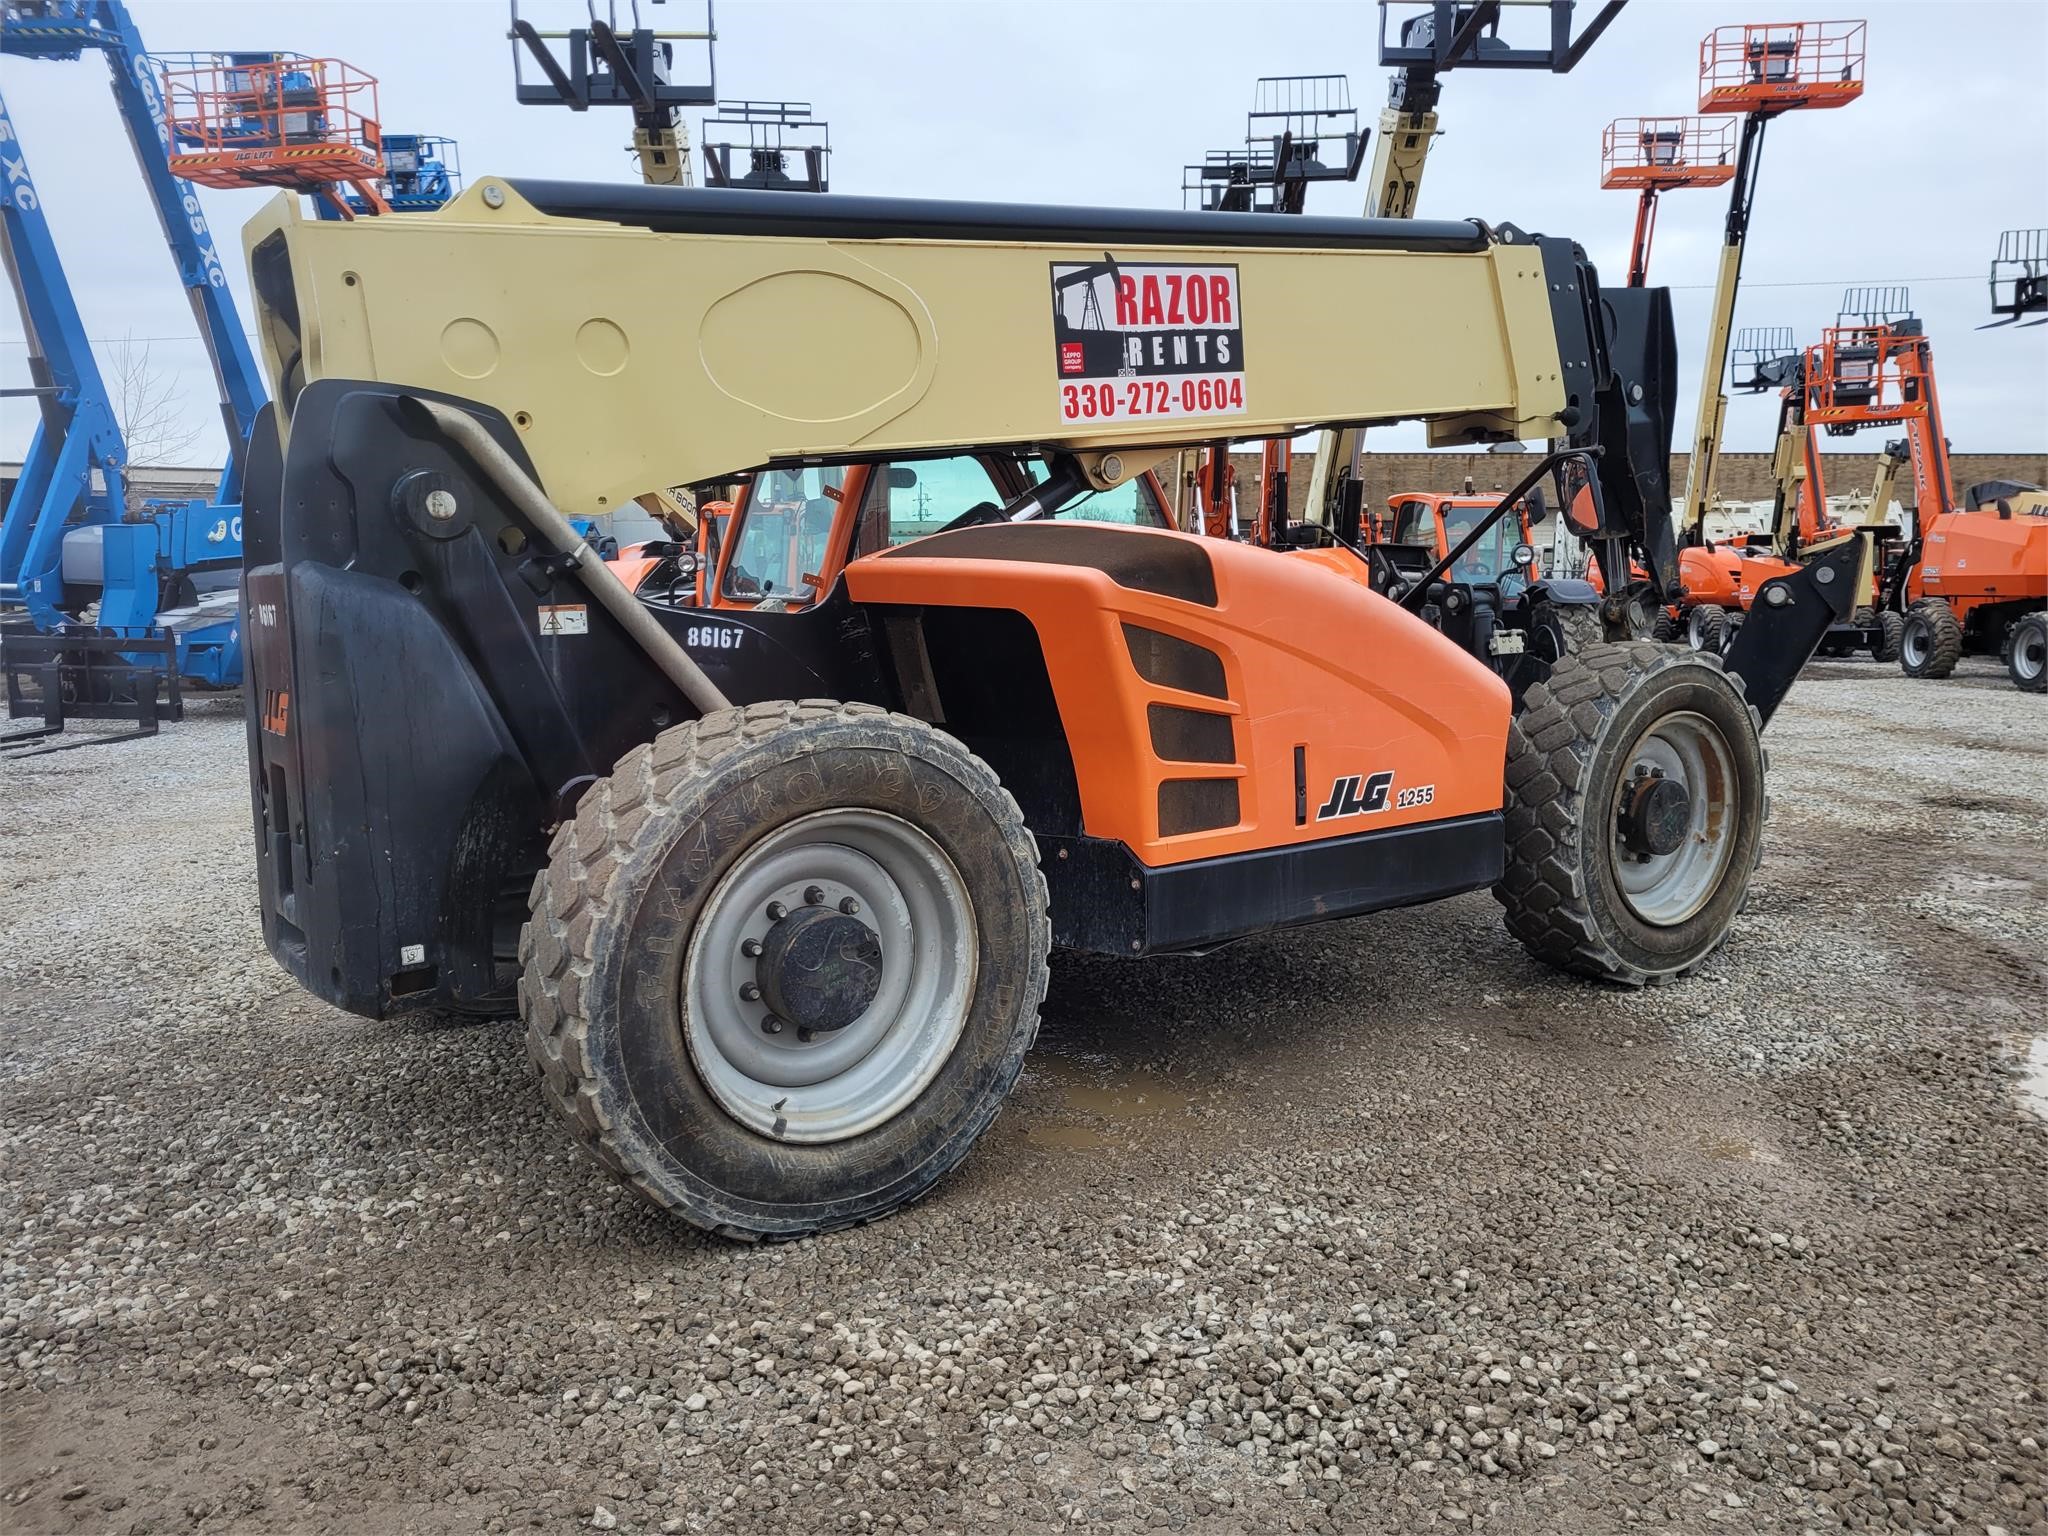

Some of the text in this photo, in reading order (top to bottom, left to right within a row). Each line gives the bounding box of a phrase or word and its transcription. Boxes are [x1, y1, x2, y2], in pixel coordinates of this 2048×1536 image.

[0, 154, 38, 211] XC
[174, 176, 225, 288] -65 XC
[1115, 274, 1232, 325] RAZOR
[1128, 334, 1231, 367] RENTS
[1063, 378, 1243, 419] 330-272-0604
[687, 626, 744, 649] 86167
[263, 689, 289, 737] JLG
[1396, 784, 1435, 810] 1255
